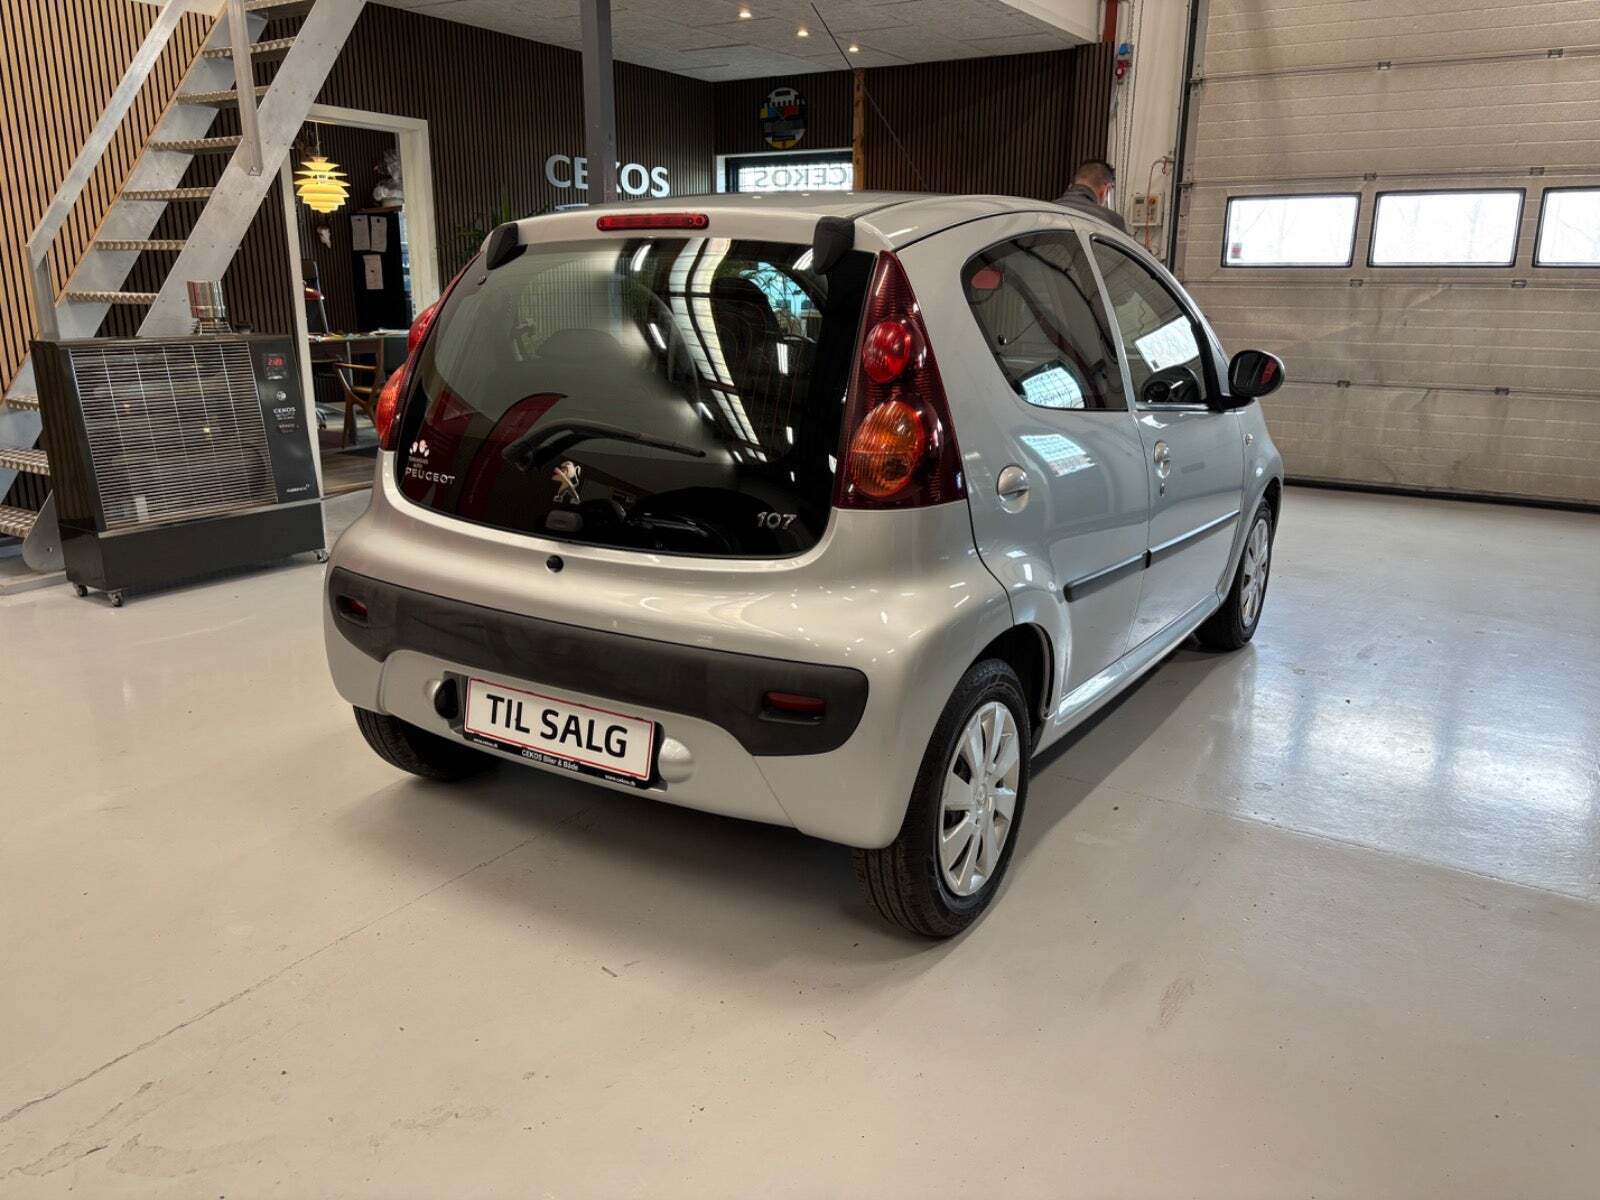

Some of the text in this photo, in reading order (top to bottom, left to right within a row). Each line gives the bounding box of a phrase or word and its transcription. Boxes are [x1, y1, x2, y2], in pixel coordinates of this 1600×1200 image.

[545, 154, 670, 198] CEOS
[405, 467, 456, 485] PEUGEOT
[757, 511, 797, 530] 107
[486, 693, 628, 758] TIL SALG
[521, 749, 542, 761] CEKOS
